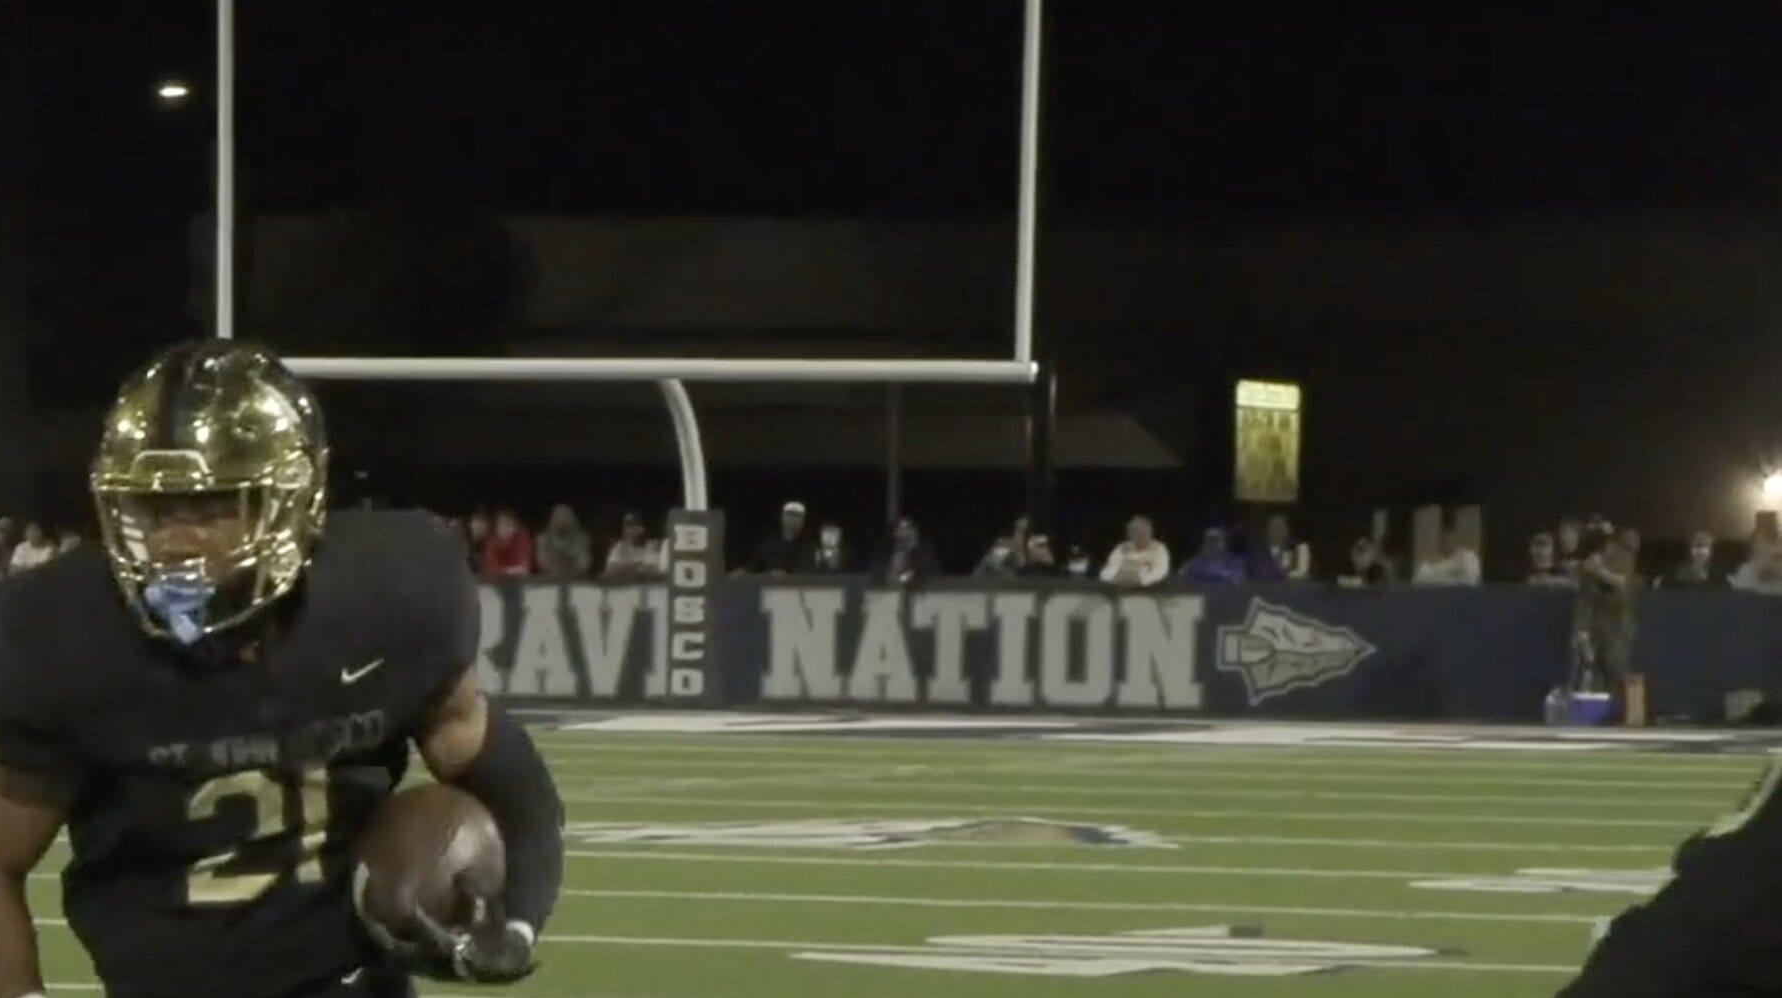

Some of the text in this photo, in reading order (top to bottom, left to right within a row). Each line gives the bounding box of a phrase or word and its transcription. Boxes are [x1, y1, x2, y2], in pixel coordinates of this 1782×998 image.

[672, 523, 709, 697] BOSCO
[760, 586, 1205, 709] NATION
[187, 767, 331, 906] 21
